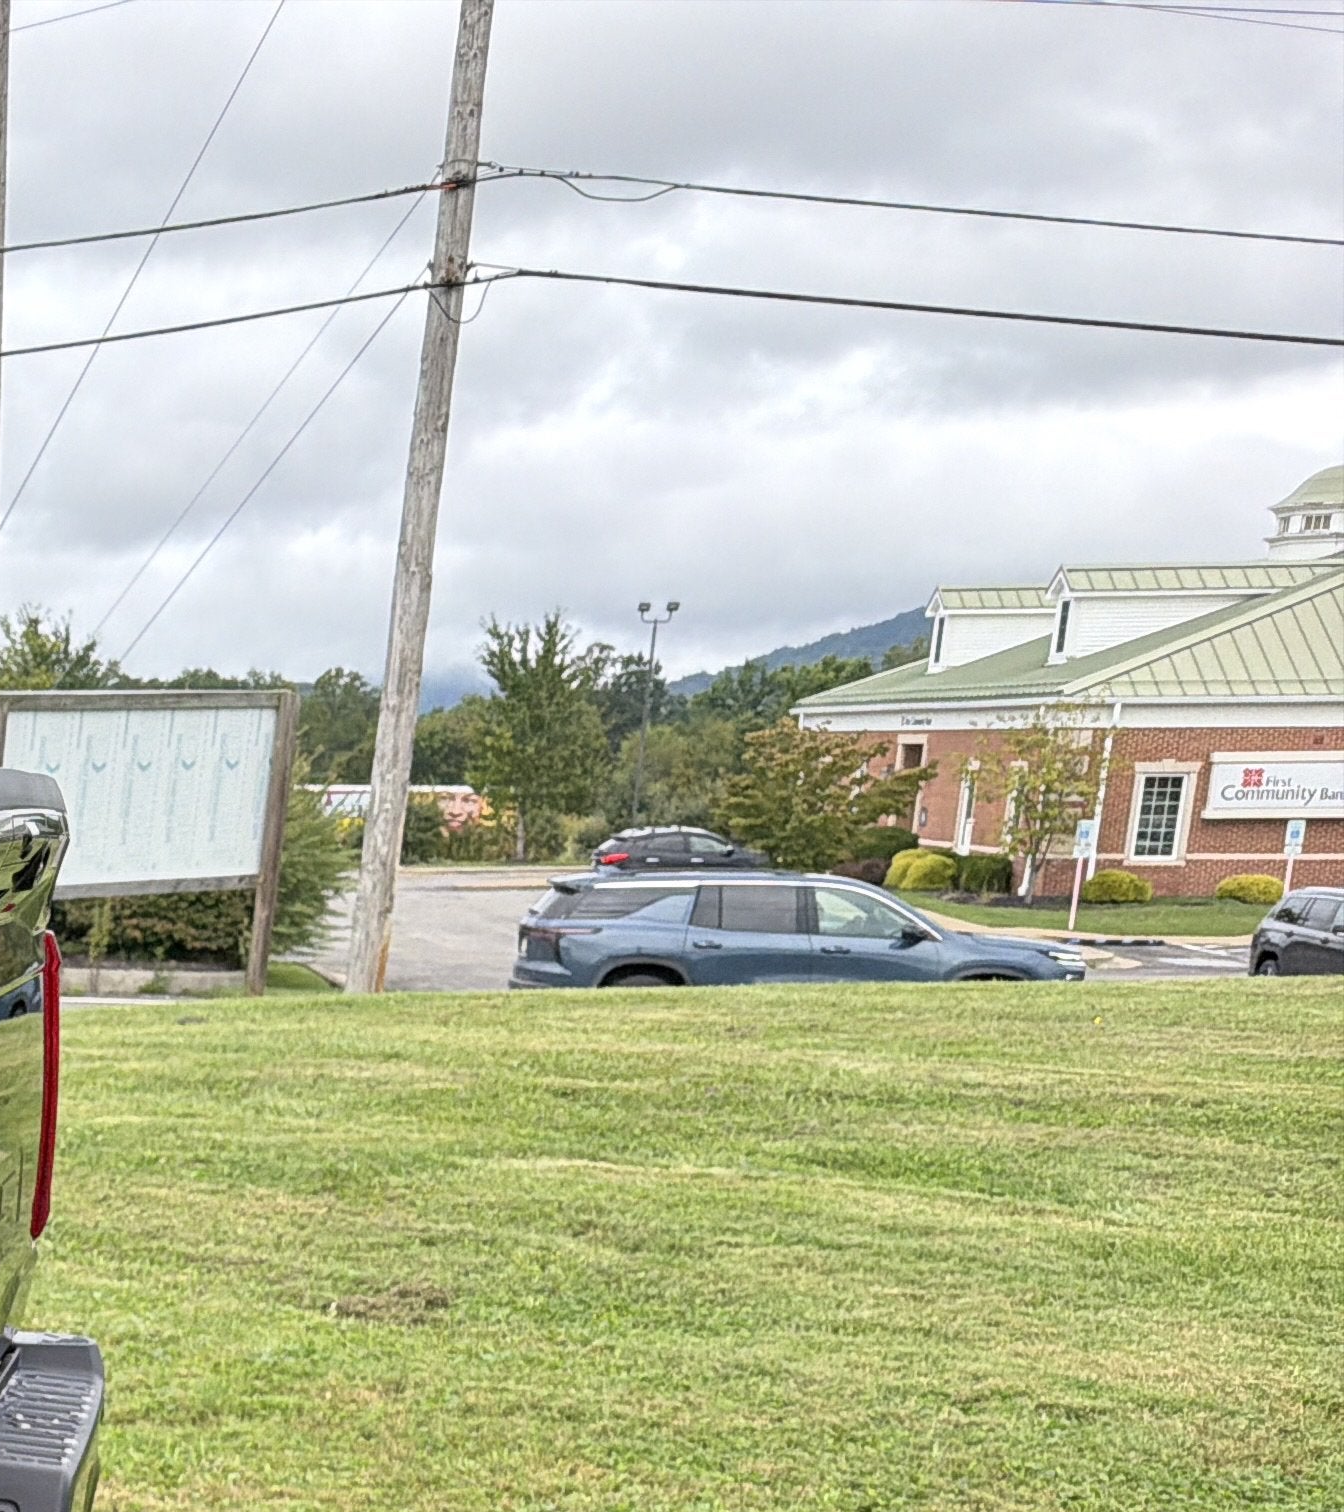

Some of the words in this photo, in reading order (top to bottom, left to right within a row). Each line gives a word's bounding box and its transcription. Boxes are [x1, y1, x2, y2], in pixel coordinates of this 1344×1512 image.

[1265, 776, 1292, 788] First
[1220, 784, 1318, 807] Community
[1319, 787, 1344, 801] Ban
